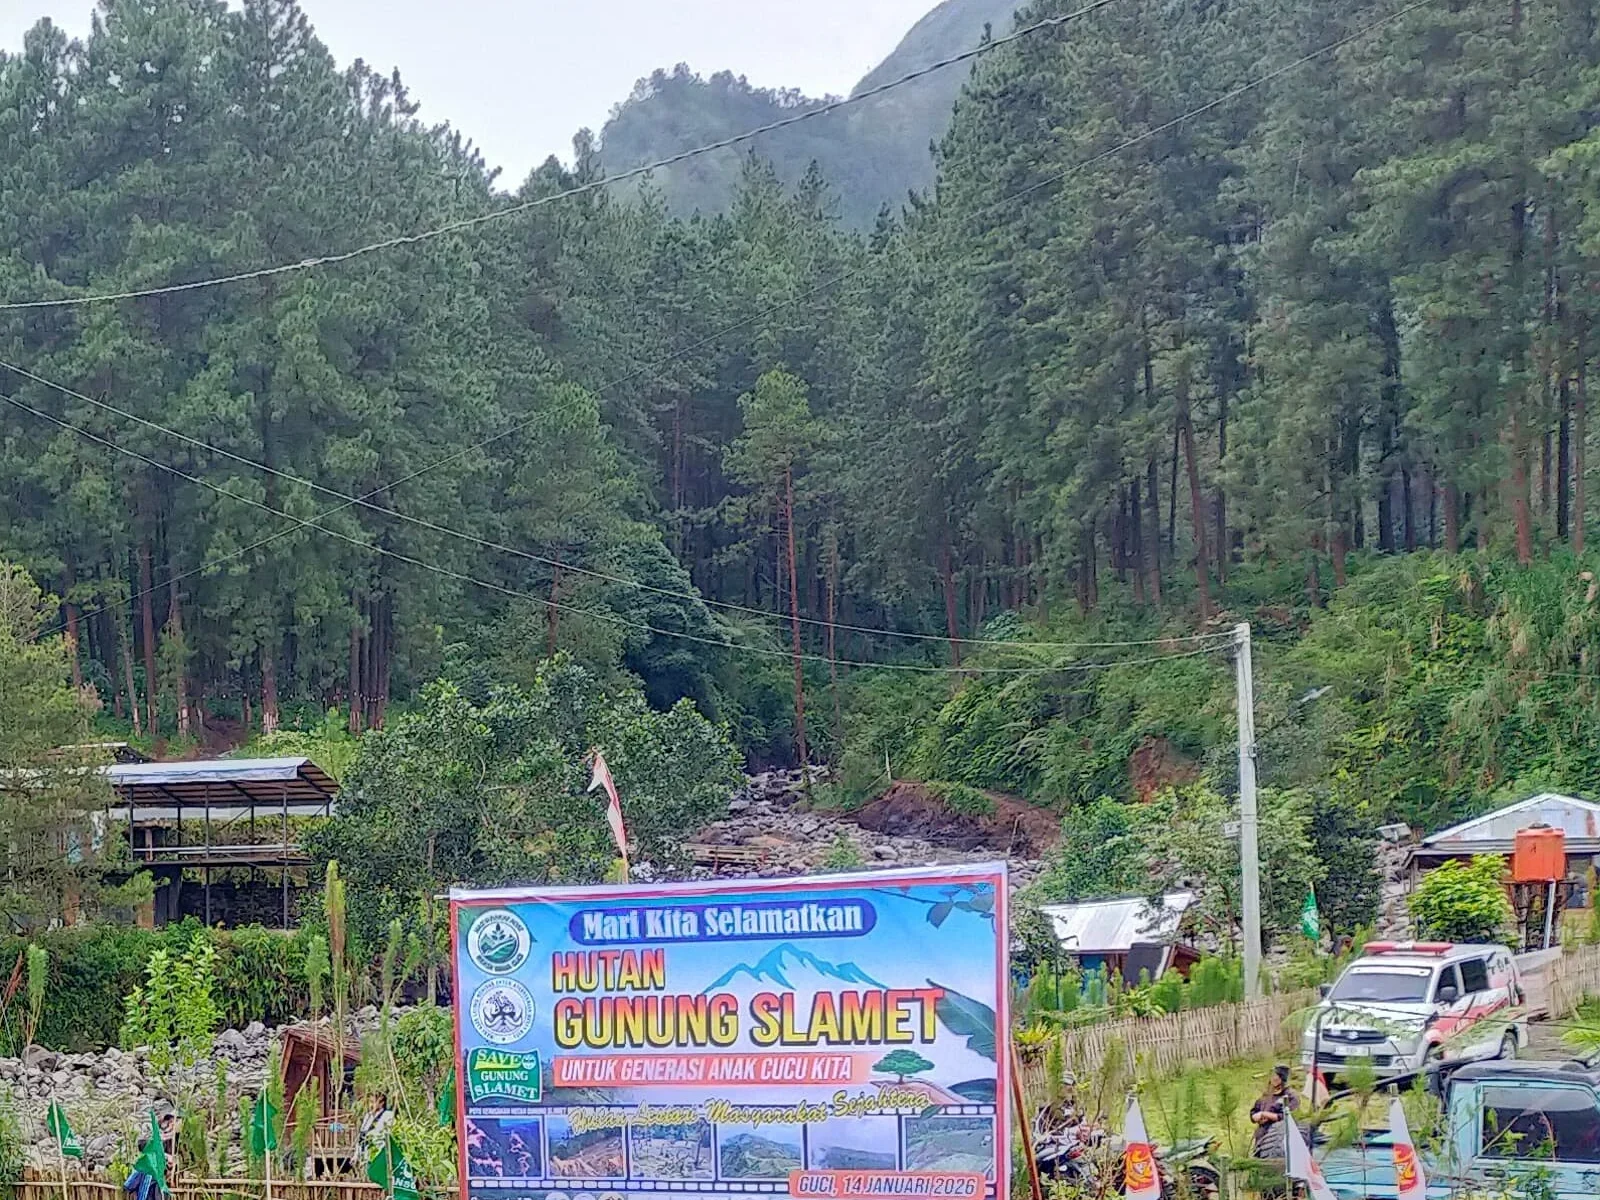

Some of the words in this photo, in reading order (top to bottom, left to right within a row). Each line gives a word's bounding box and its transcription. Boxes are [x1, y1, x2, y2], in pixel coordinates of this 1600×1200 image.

[583, 908, 639, 940] Mari
[645, 908, 700, 938] Kita
[705, 903, 863, 937] Selamatkan
[552, 947, 666, 993] HUTAN
[554, 991, 739, 1050] GUNUNG
[750, 988, 945, 1047] SLAMET
[477, 1049, 522, 1070] SAVE
[561, 1058, 615, 1081] UNTUK
[621, 1058, 704, 1081] GENERASI
[707, 1057, 755, 1081] ANAK
[760, 1056, 809, 1080] CUCU
[810, 1055, 852, 1080] KITA
[480, 1070, 529, 1081] GUNUNG
[473, 1084, 538, 1099] SLAMET
[703, 1096, 828, 1128] Masyarakat
[832, 1084, 930, 1119] Sejahtera
[799, 1176, 837, 1197] GUCI,
[843, 1176, 862, 1194] 14
[865, 1176, 930, 1196] JANUARI
[933, 1177, 977, 1196] 2026
